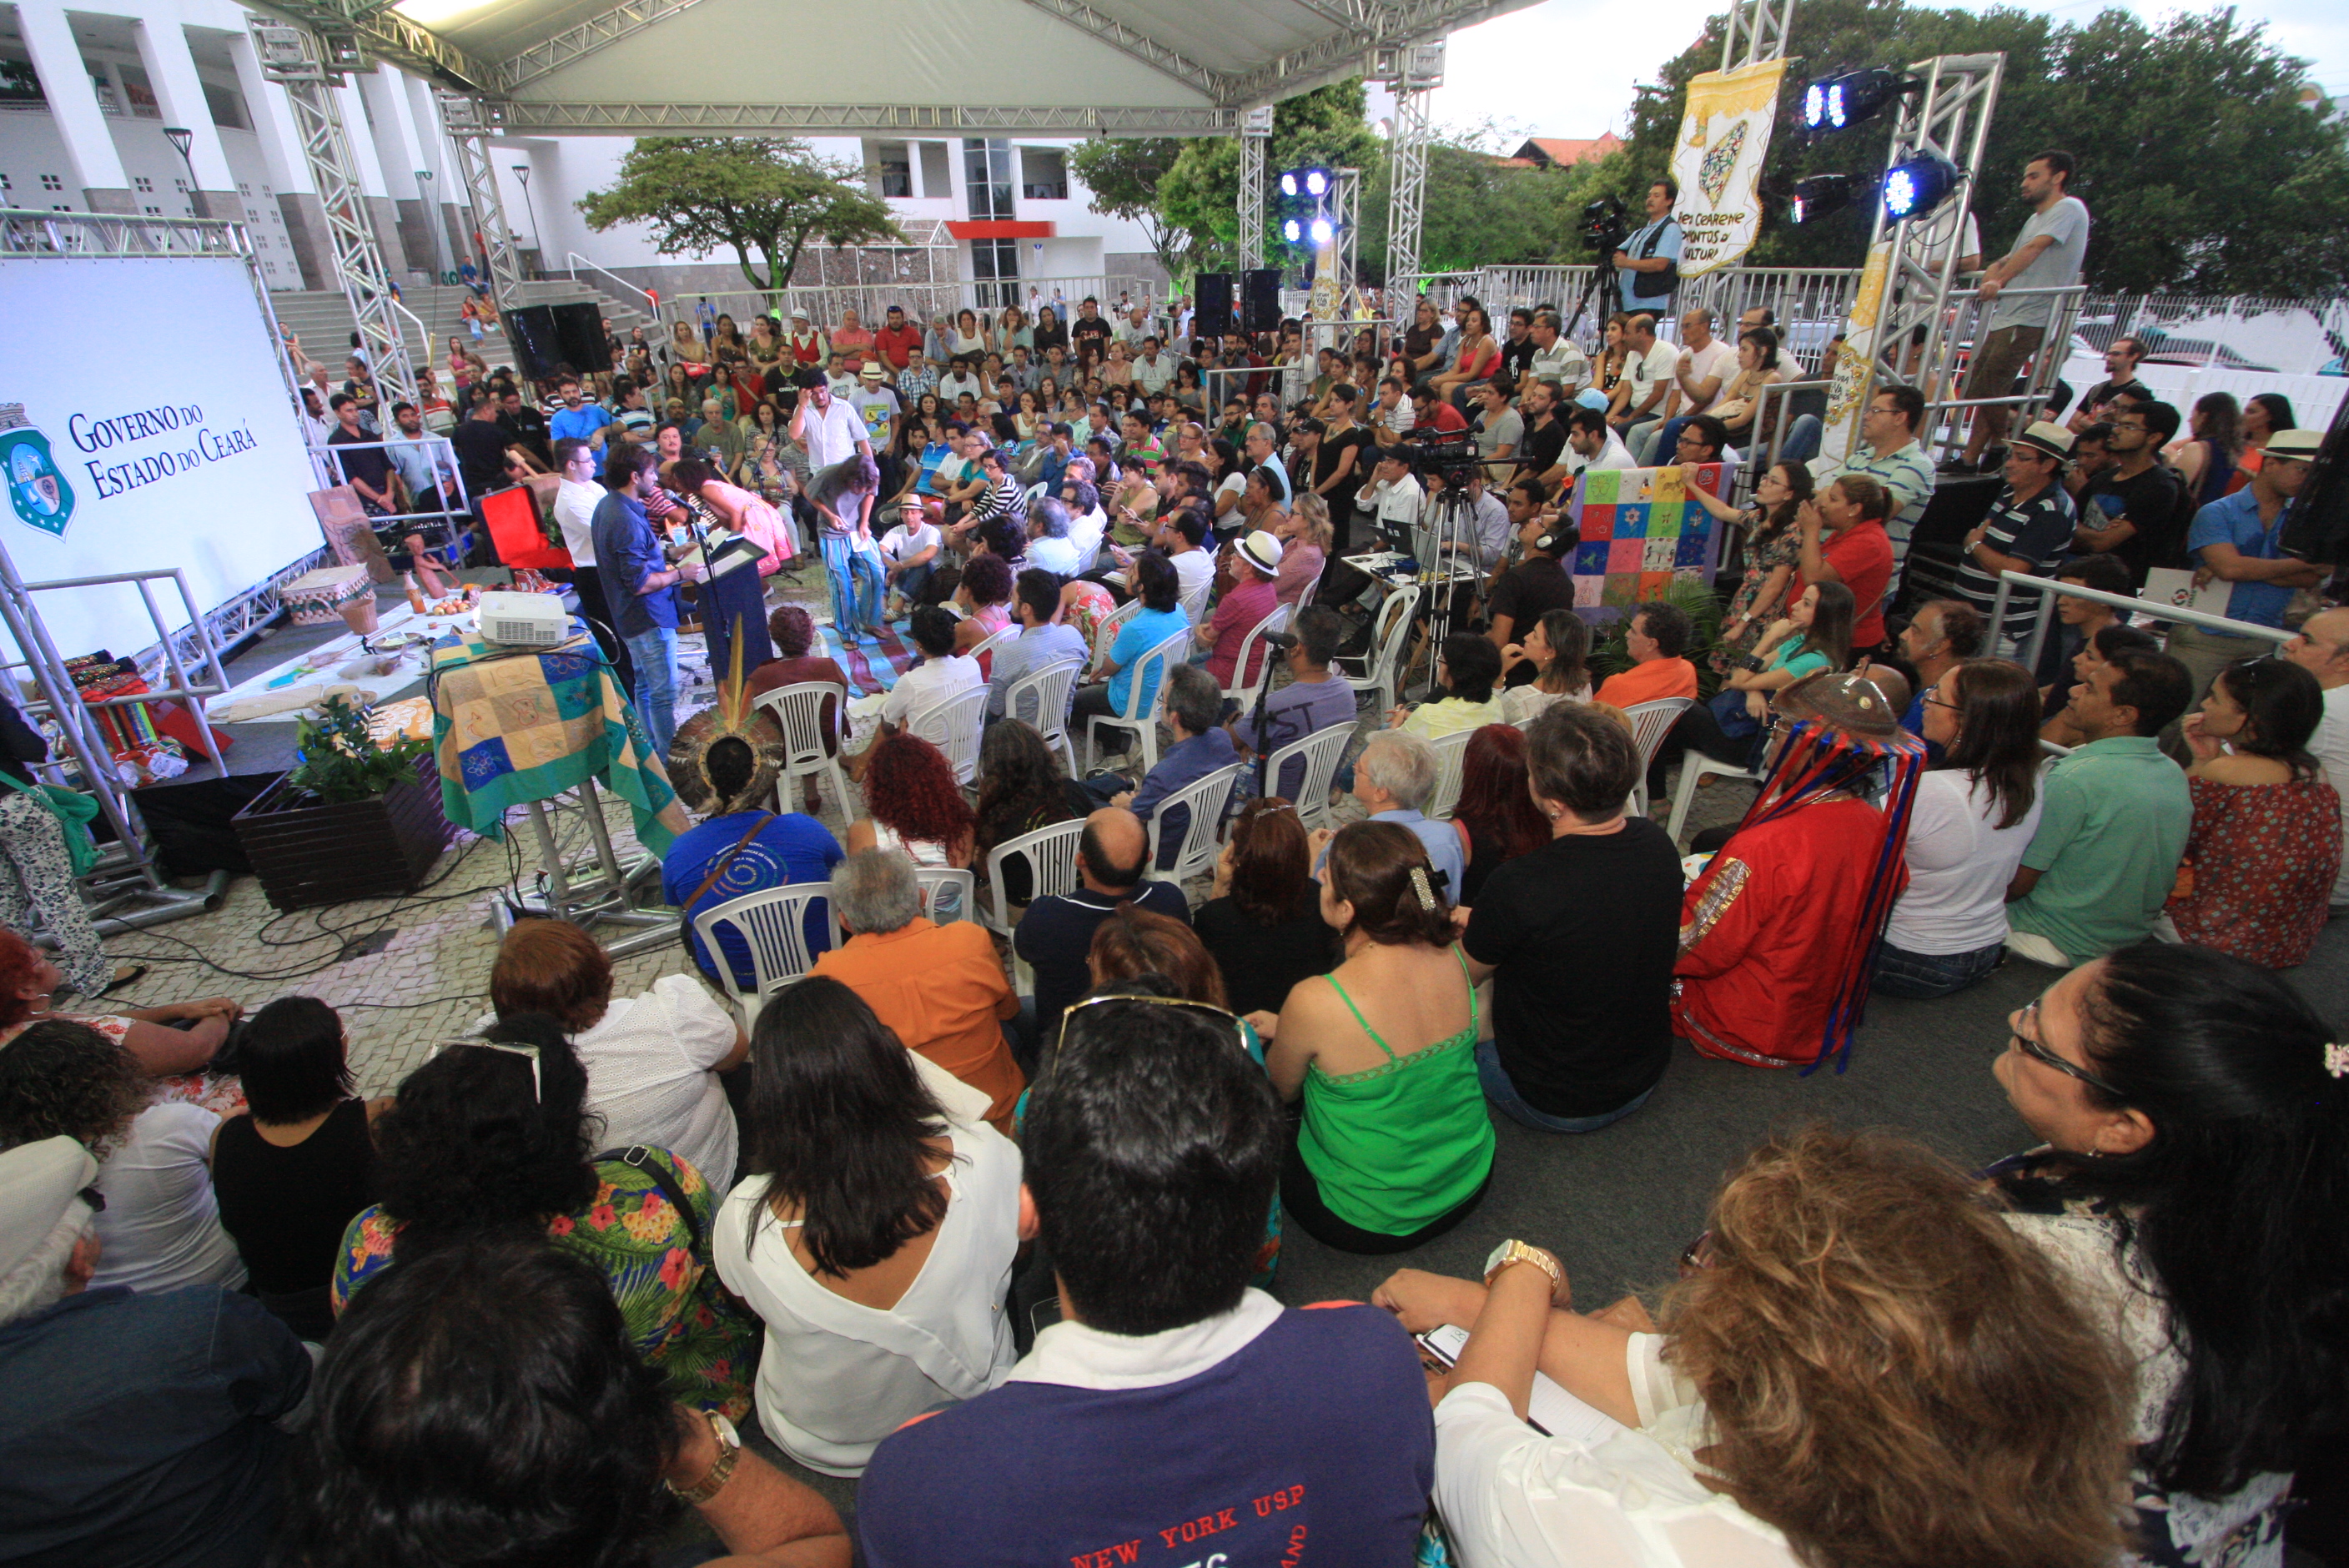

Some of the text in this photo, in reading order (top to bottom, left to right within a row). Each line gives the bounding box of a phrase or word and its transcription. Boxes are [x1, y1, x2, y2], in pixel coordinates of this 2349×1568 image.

[68, 405, 204, 454] GOVERNO DO
[84, 418, 258, 500] ESTADO DO CEARÁ
[1070, 1539, 1141, 1568] NEW
[1159, 1507, 1239, 1549] YORK
